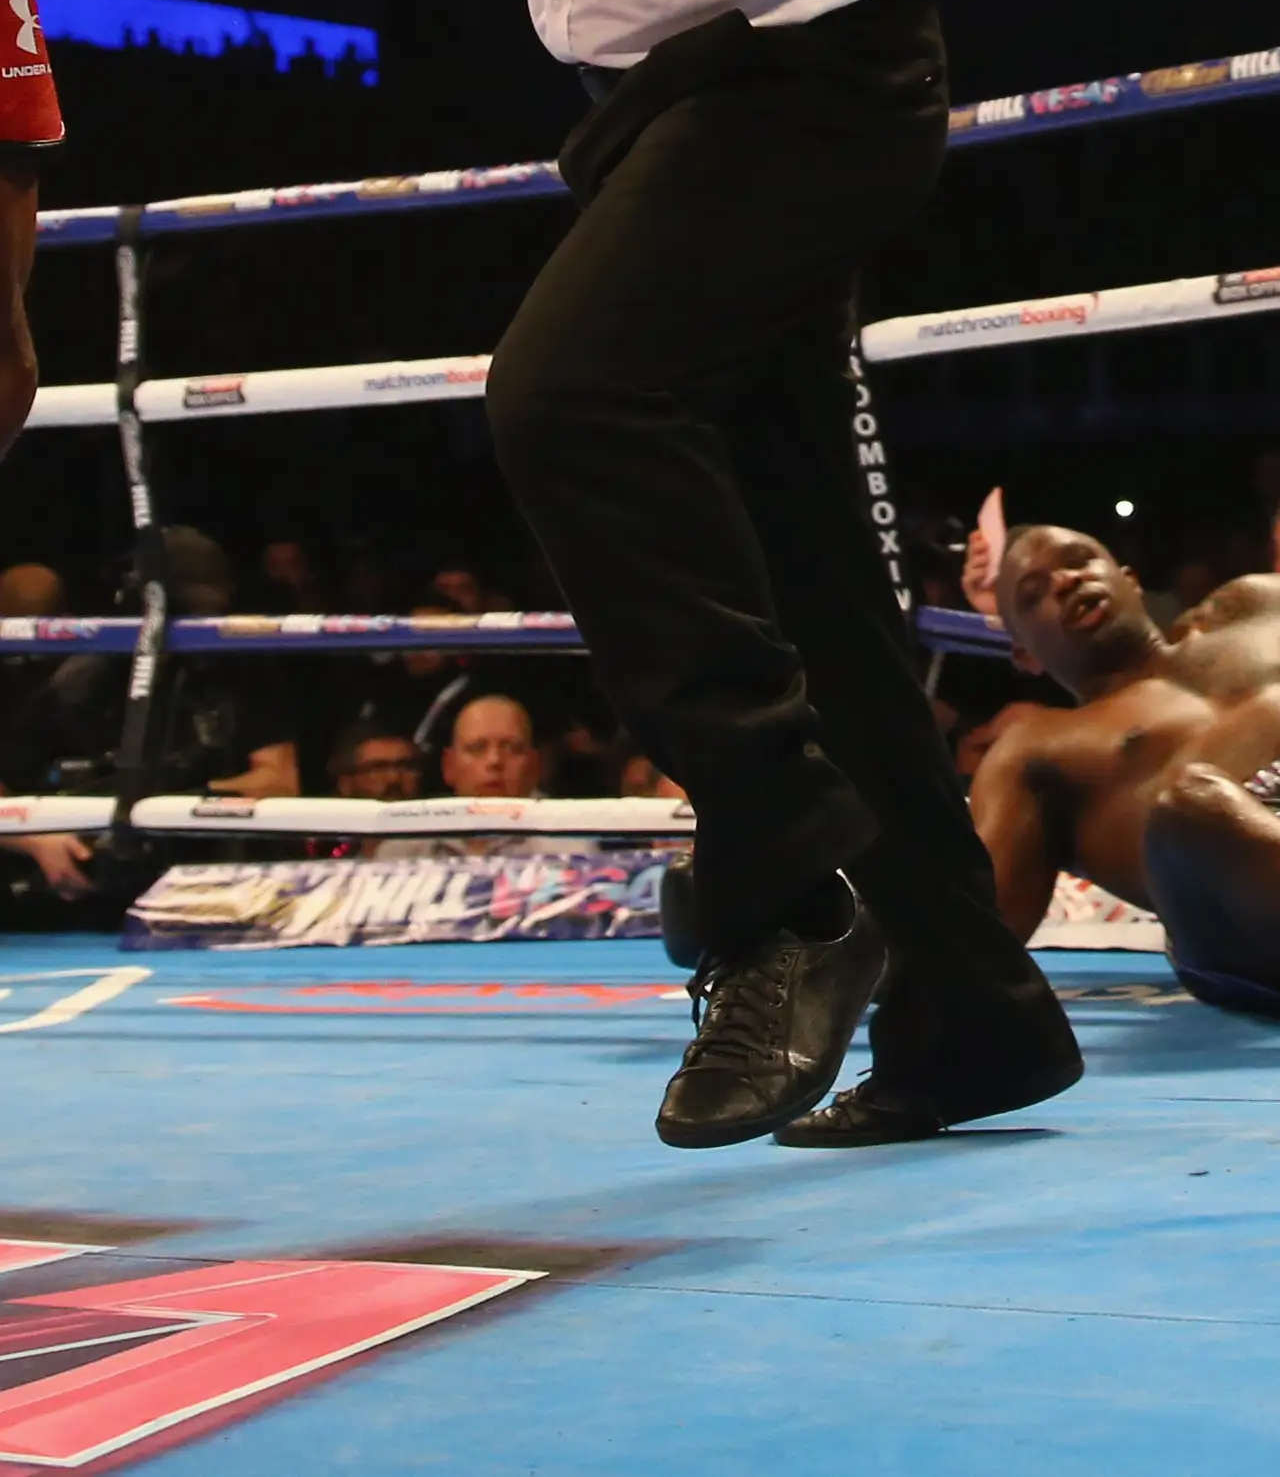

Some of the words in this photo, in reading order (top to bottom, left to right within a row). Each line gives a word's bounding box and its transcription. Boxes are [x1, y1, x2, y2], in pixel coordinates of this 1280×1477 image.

[1, 63, 46, 79] UNDER
[976, 95, 1026, 126] HILL
[917, 306, 1087, 340] matchroomboxing
